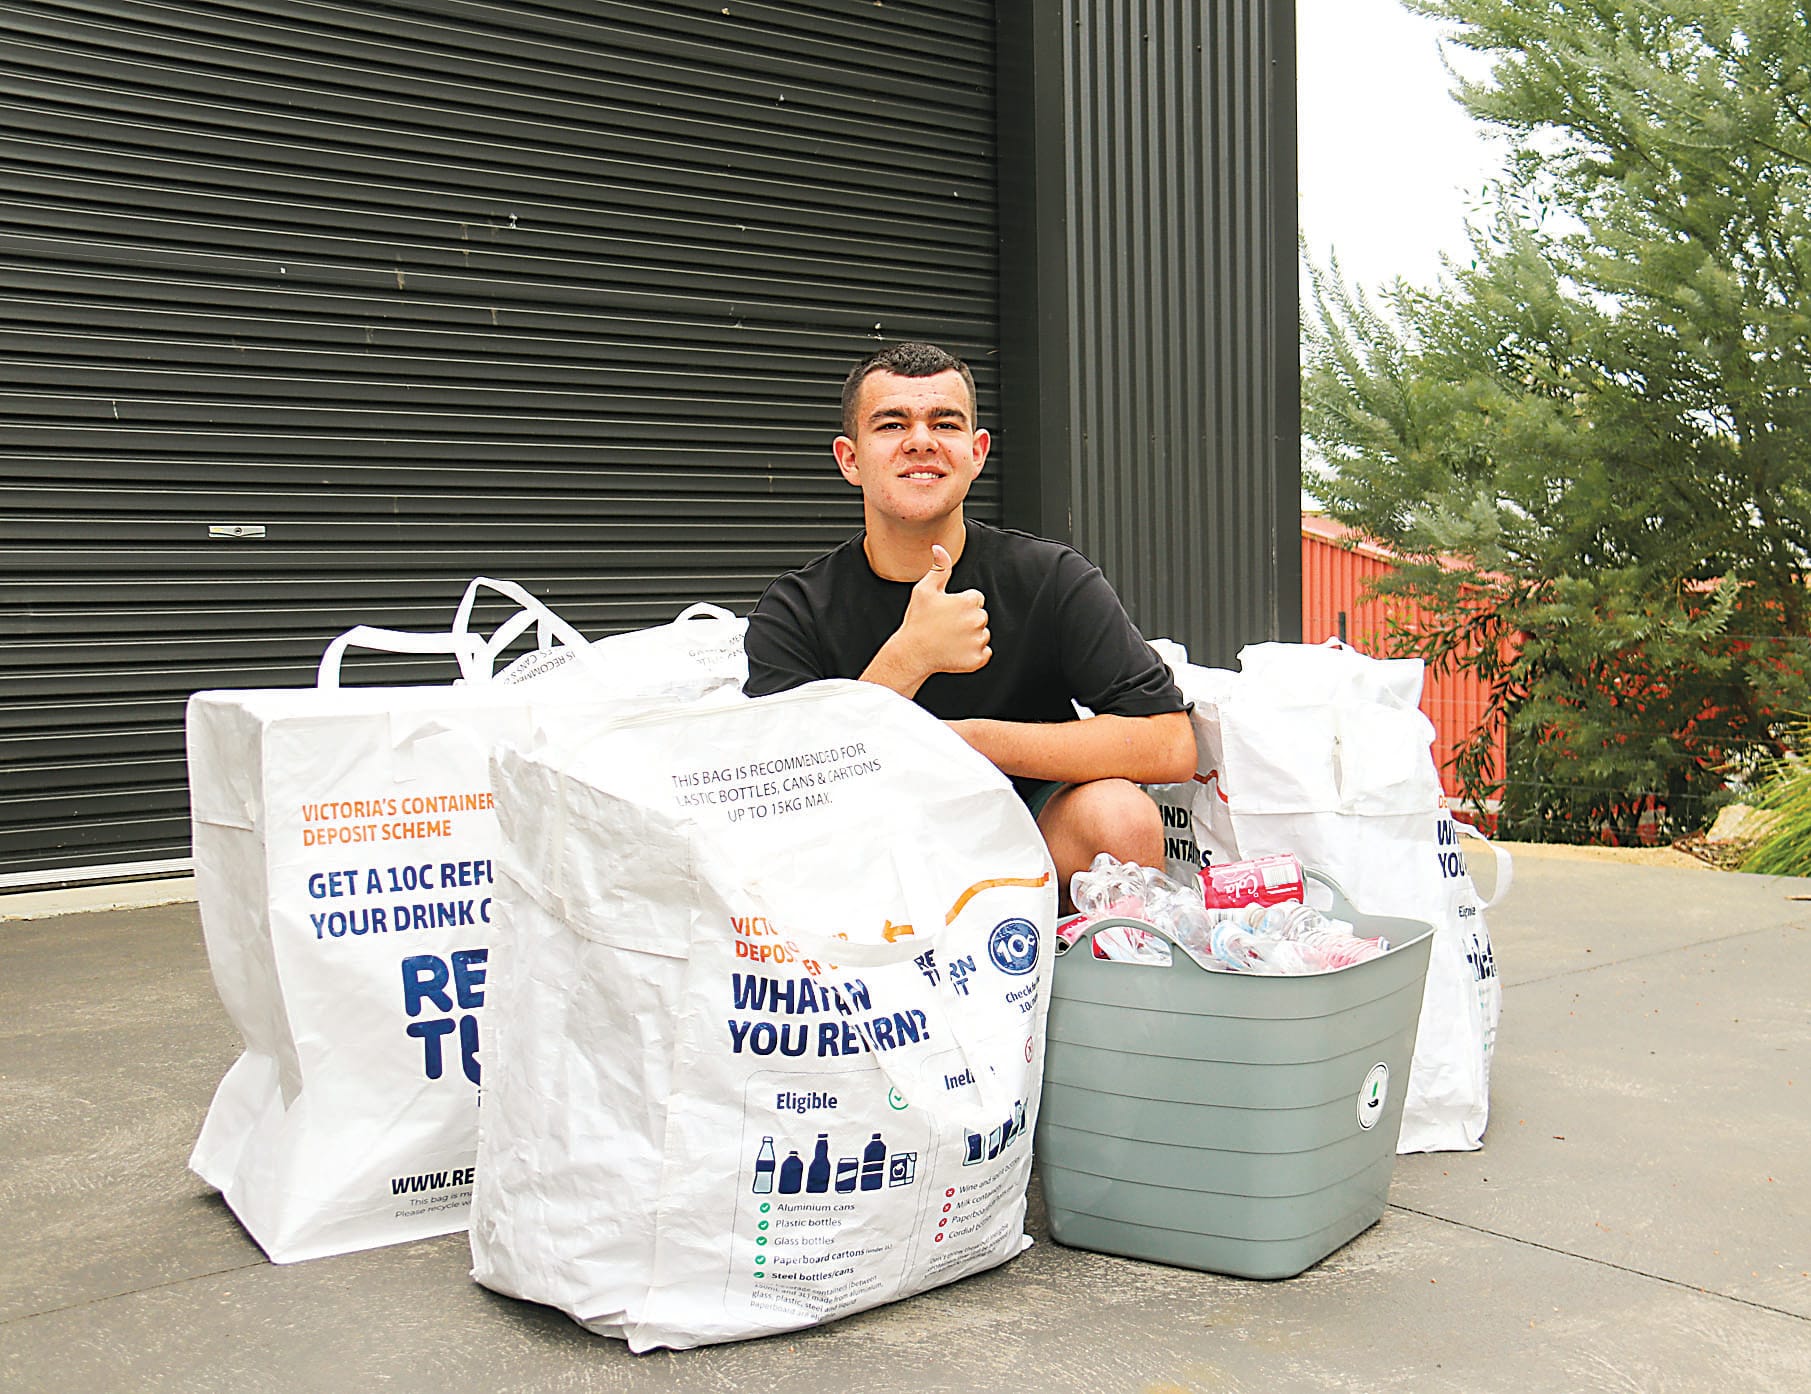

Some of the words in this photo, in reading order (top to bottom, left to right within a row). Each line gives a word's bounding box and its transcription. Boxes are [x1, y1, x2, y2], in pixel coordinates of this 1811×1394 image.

[672, 772, 699, 788] THIS
[702, 769, 732, 784] BAG
[736, 766, 747, 779] IS
[750, 749, 838, 777] RECOMMENDED
[840, 743, 866, 759] FOR
[719, 781, 780, 803] BOTTLES,
[783, 774, 814, 791] CANS
[818, 772, 826, 784] &
[828, 759, 881, 783] CARTONS
[302, 798, 397, 822] VICTORIA'S
[401, 793, 495, 817] CONTAINER
[728, 808, 745, 822] UP
[747, 805, 767, 819] TO
[772, 797, 801, 815] 15KG
[805, 792, 832, 808] MAX.
[303, 825, 376, 846] DEPOSIT
[381, 820, 452, 841] SCHEME
[308, 869, 358, 899] GET
[366, 868, 383, 894] A
[387, 864, 433, 892] 10C
[1224, 875, 1258, 899] Cola
[310, 907, 387, 939] YOUR
[394, 899, 475, 935] DRINK
[401, 948, 489, 1017] RE
[728, 1020, 809, 1057] YOU
[776, 1092, 838, 1114] Eligible
[391, 1167, 475, 1195] WWW.RE
[395, 1208, 426, 1218] Please
[428, 1201, 459, 1212] recycle
[409, 1198, 428, 1207] This
[431, 1195, 448, 1204] bag
[777, 1203, 831, 1212] Aluminium
[833, 1203, 855, 1211] cans
[775, 1219, 806, 1228] Plastic
[808, 1217, 842, 1227] bottles
[774, 1237, 799, 1246] Glass
[801, 1235, 835, 1246] bottles
[773, 1253, 830, 1266] Paperboard
[832, 1248, 865, 1260] cartons
[771, 1272, 796, 1280] Steel
[799, 1267, 854, 1281] bottles/cans
